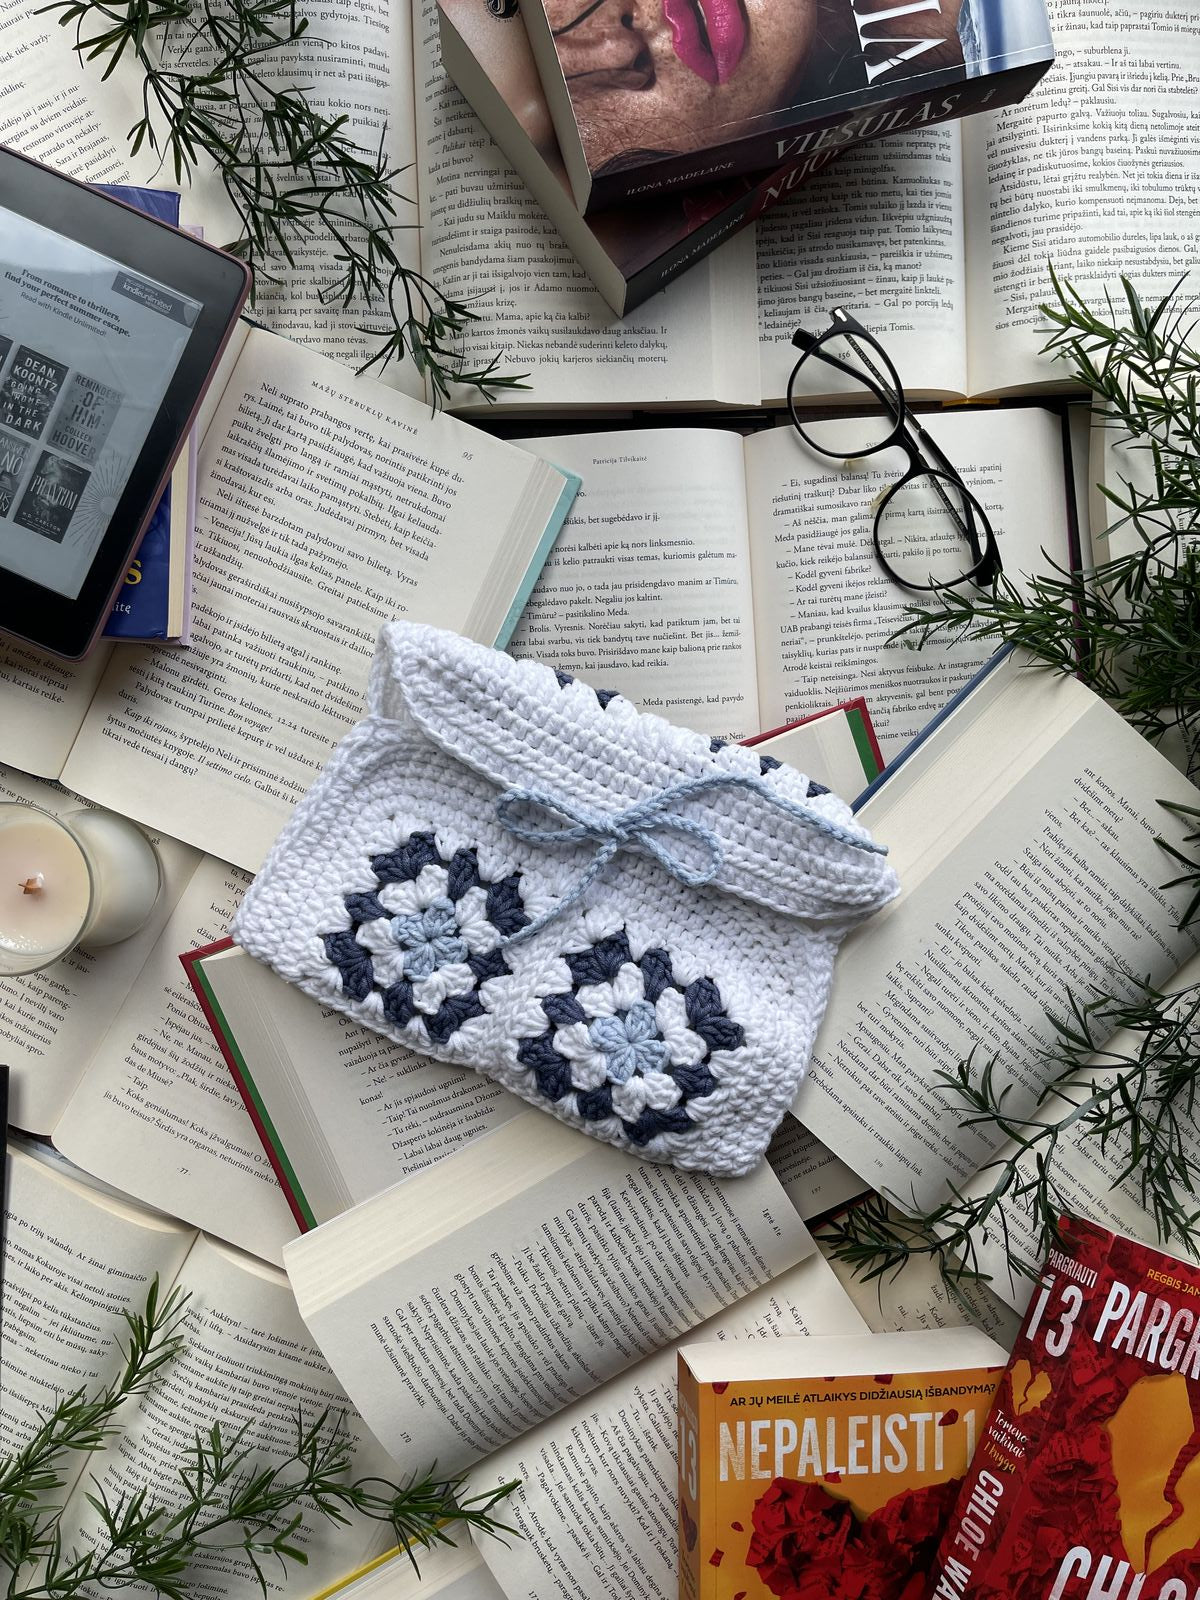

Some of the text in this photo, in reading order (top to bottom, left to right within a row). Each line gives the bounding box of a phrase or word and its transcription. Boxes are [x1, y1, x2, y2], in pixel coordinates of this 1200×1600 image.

[29, 123, 39, 131] su
[39, 111, 62, 126] dviem
[776, 92, 961, 160] VIESULAS
[626, 161, 735, 196] ILONA MADELAINE
[1017, 167, 1026, 176] ir
[660, 214, 744, 278] ILONA MADELAINE
[4, 271, 131, 338] find your perfect summer escape.
[21, 268, 121, 322] From romance to thrillers,
[20, 291, 107, 338] Read with Kindle Unlimited!
[24, 357, 56, 378] DEAN
[838, 350, 851, 360] 156
[10, 381, 41, 395] GOING
[13, 365, 58, 393] KOONTZ
[75, 375, 123, 400] REMINDERS
[2, 401, 39, 417] IN THE
[5, 413, 42, 432] DARK
[64, 425, 93, 443] COLLEEN
[259, 381, 465, 483] Neli suprato prabangos vertę, kai prasivėrė kupė du-
[51, 430, 97, 459] HOOVER
[30, 475, 78, 511] PHANTOM
[577, 542, 603, 552] kalbėti
[603, 541, 619, 552] apie
[620, 540, 630, 551] ką
[631, 541, 648, 549] nors
[648, 537, 695, 548] linksmesnio.
[774, 525, 871, 543] Meda pasidžiaugė jos galia.
[794, 564, 872, 580] Kodėl gyveni fabrike?
[584, 661, 596, 670] kai
[596, 659, 630, 671] jausdavo,
[631, 658, 645, 668] kad
[646, 658, 669, 667] reikia.
[782, 657, 879, 673] Atrodė keistai reikšmingos.
[101, 727, 199, 776] tikrai vedė tiesiai į dangų?
[124, 1055, 137, 1067] das
[136, 1063, 147, 1073] de
[806, 1069, 843, 1105] Drebėdama
[841, 1103, 869, 1128] apsisuku
[866, 1124, 875, 1133] ir
[873, 1131, 896, 1153] traukiu
[1048, 1248, 1098, 1289] PARGRIAUTI
[1147, 1268, 1182, 1290] REGBIS
[59, 1363, 82, 1375] nieko
[383, 1343, 408, 1378] užsimanė
[730, 1383, 996, 1408] AR JŲ MEILĖ ATLAIKYS DIDŽIAUSIĄ IŠBANDYMĄ?
[400, 1432, 412, 1443] 170
[995, 1409, 1028, 1443] Tomeno
[719, 1409, 944, 1482] NEPALEISTI
[988, 1425, 1025, 1458] vaikinai
[988, 1443, 1016, 1475] knyga
[931, 1469, 1004, 1600] CHLOE WA
